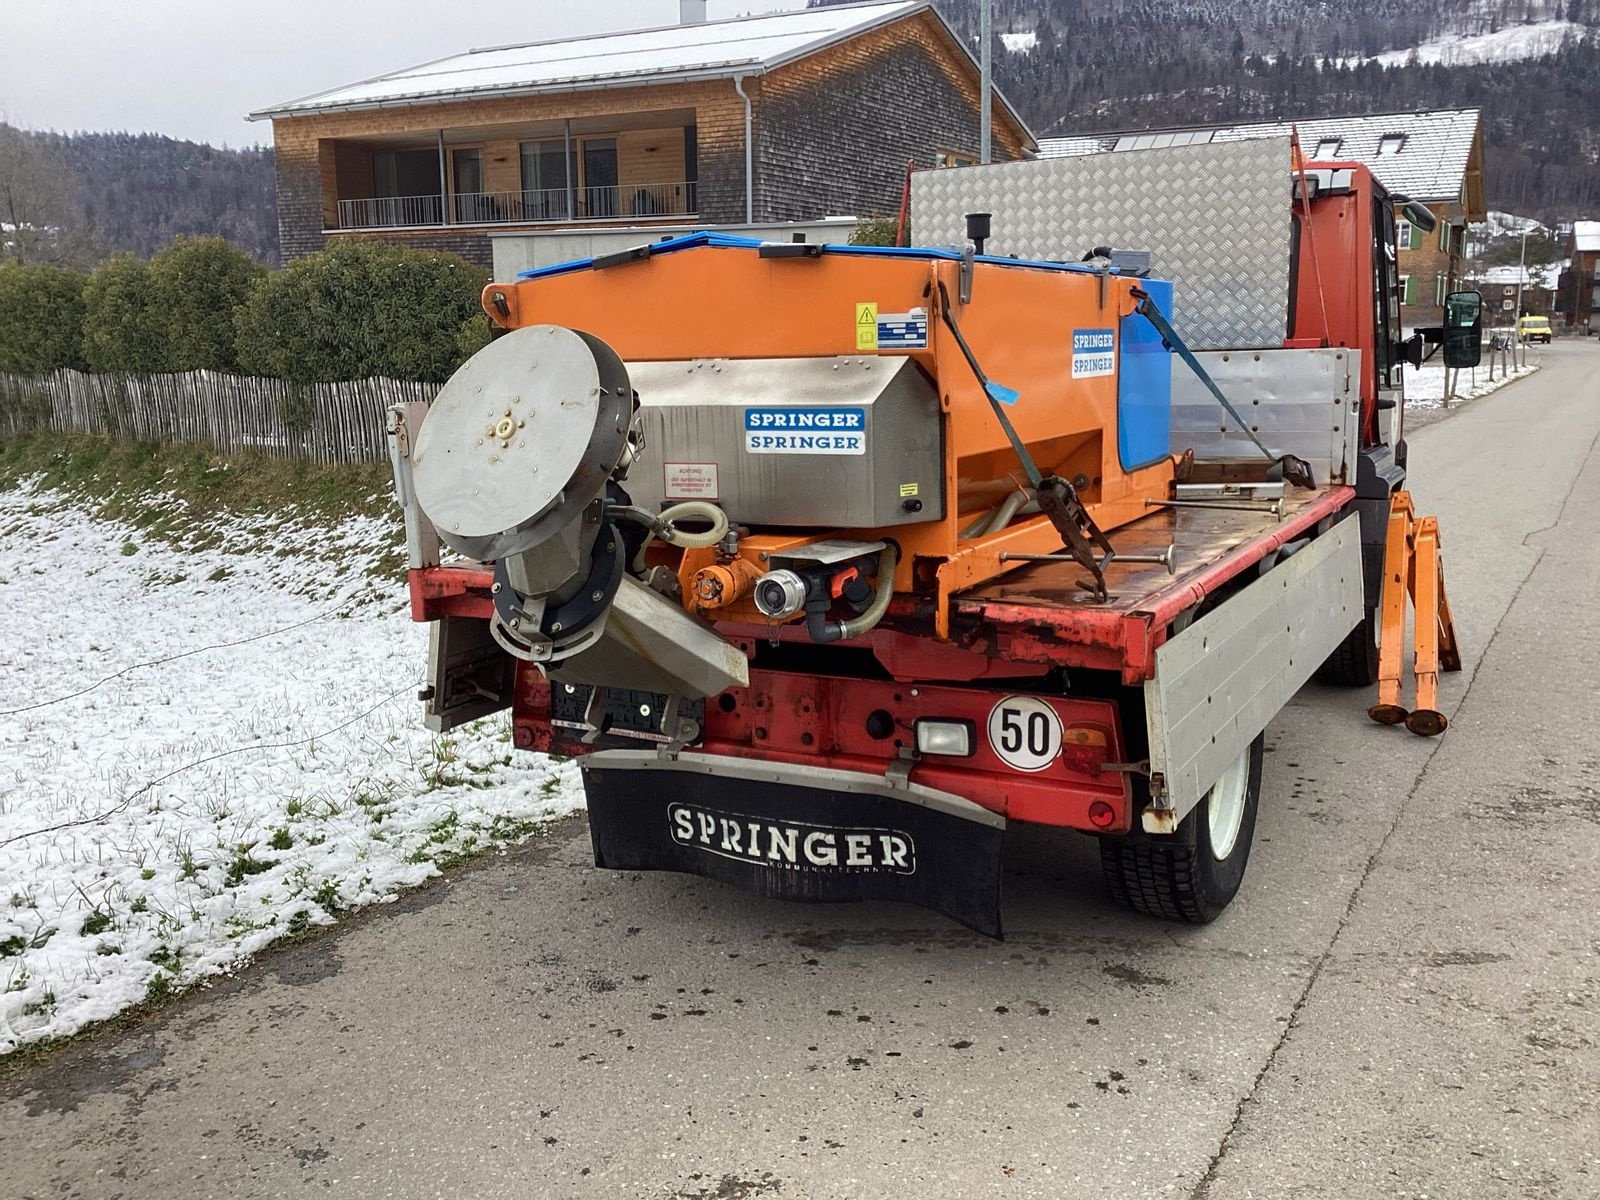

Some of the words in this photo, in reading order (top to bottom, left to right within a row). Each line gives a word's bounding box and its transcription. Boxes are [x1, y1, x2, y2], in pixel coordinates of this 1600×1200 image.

[1074, 334, 1113, 349] SPRINGER
[1074, 358, 1113, 373] SPRINGER
[750, 413, 860, 427] SPRINGER
[751, 436, 860, 449] SPRINGER
[1001, 708, 1050, 757] 50
[674, 808, 909, 868] SPRINGER
